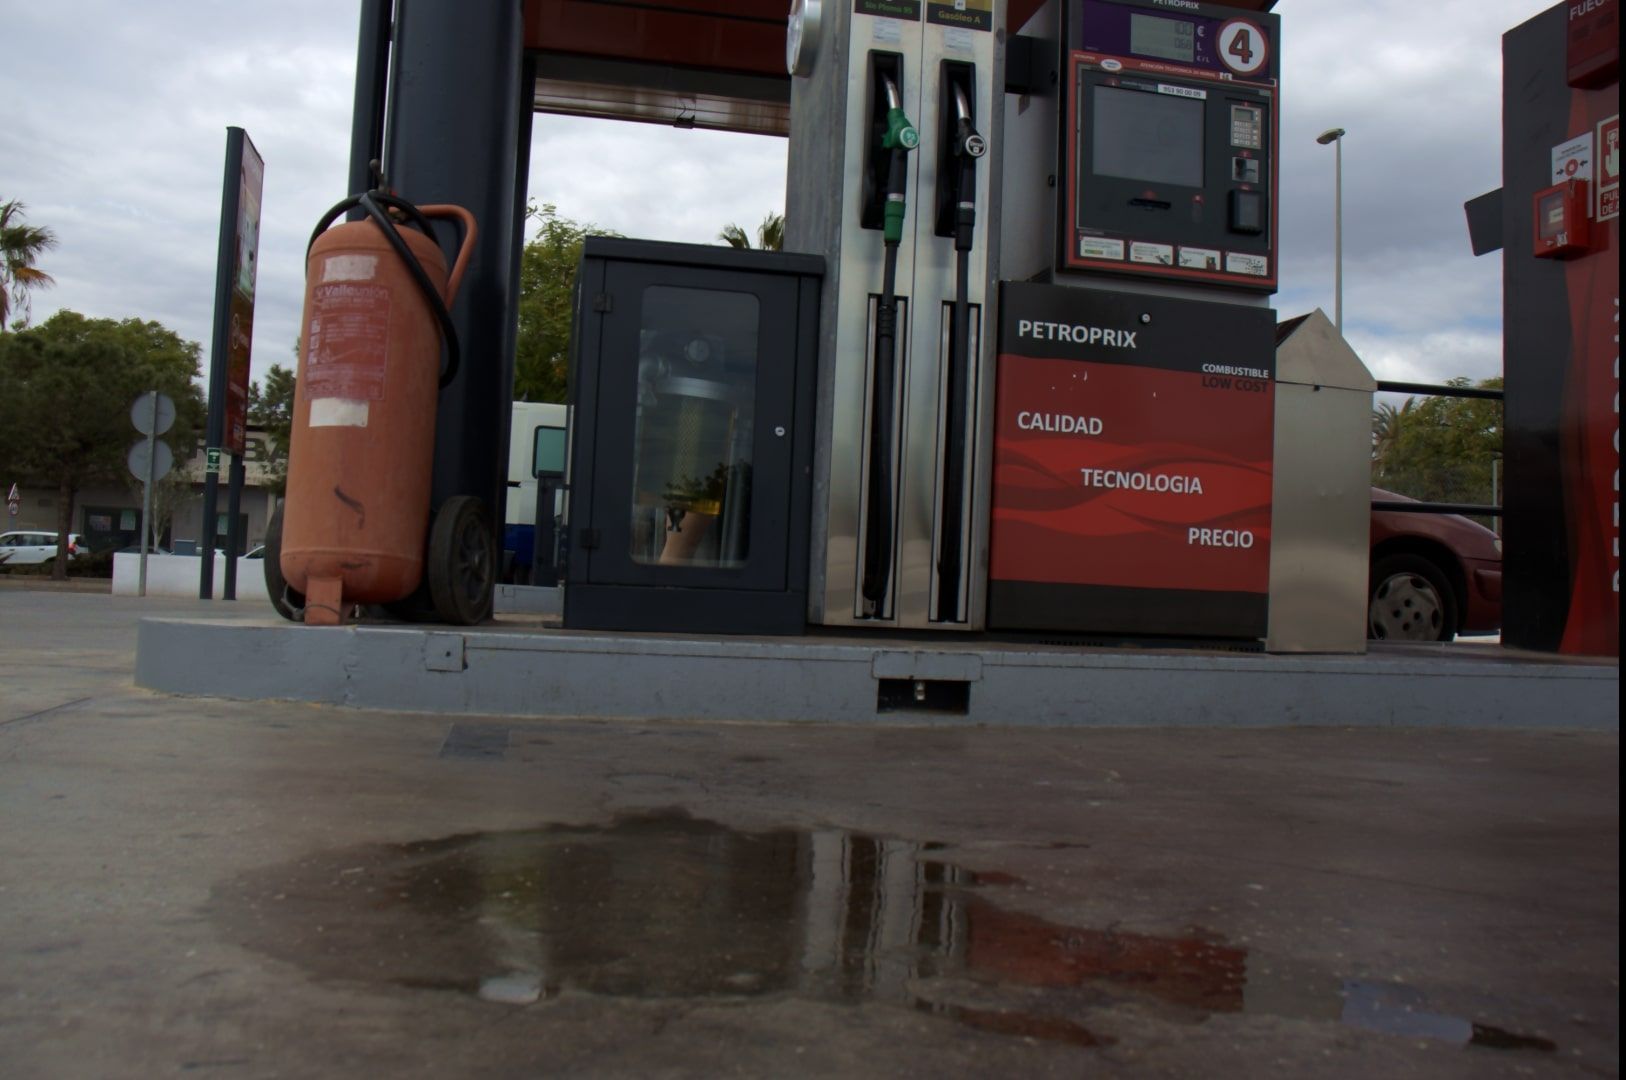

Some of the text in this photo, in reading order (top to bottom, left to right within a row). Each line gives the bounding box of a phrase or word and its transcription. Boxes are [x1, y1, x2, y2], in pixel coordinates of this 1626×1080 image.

[1153, 0, 1200, 10] PETROPRIX
[1569, 0, 1607, 21] FUE
[938, 10, 981, 24] Gasóleo A
[1228, 28, 1254, 64] 4
[1602, 201, 1613, 215] DE
[1018, 319, 1137, 349] PETROPRIX
[1202, 363, 1269, 379] COMBUSTIBLE
[1202, 376, 1269, 393] LOW COST
[1017, 411, 1103, 436] CALIDAD
[1081, 468, 1203, 495] TECNOLOGIA
[1188, 527, 1254, 548] PRECIO
